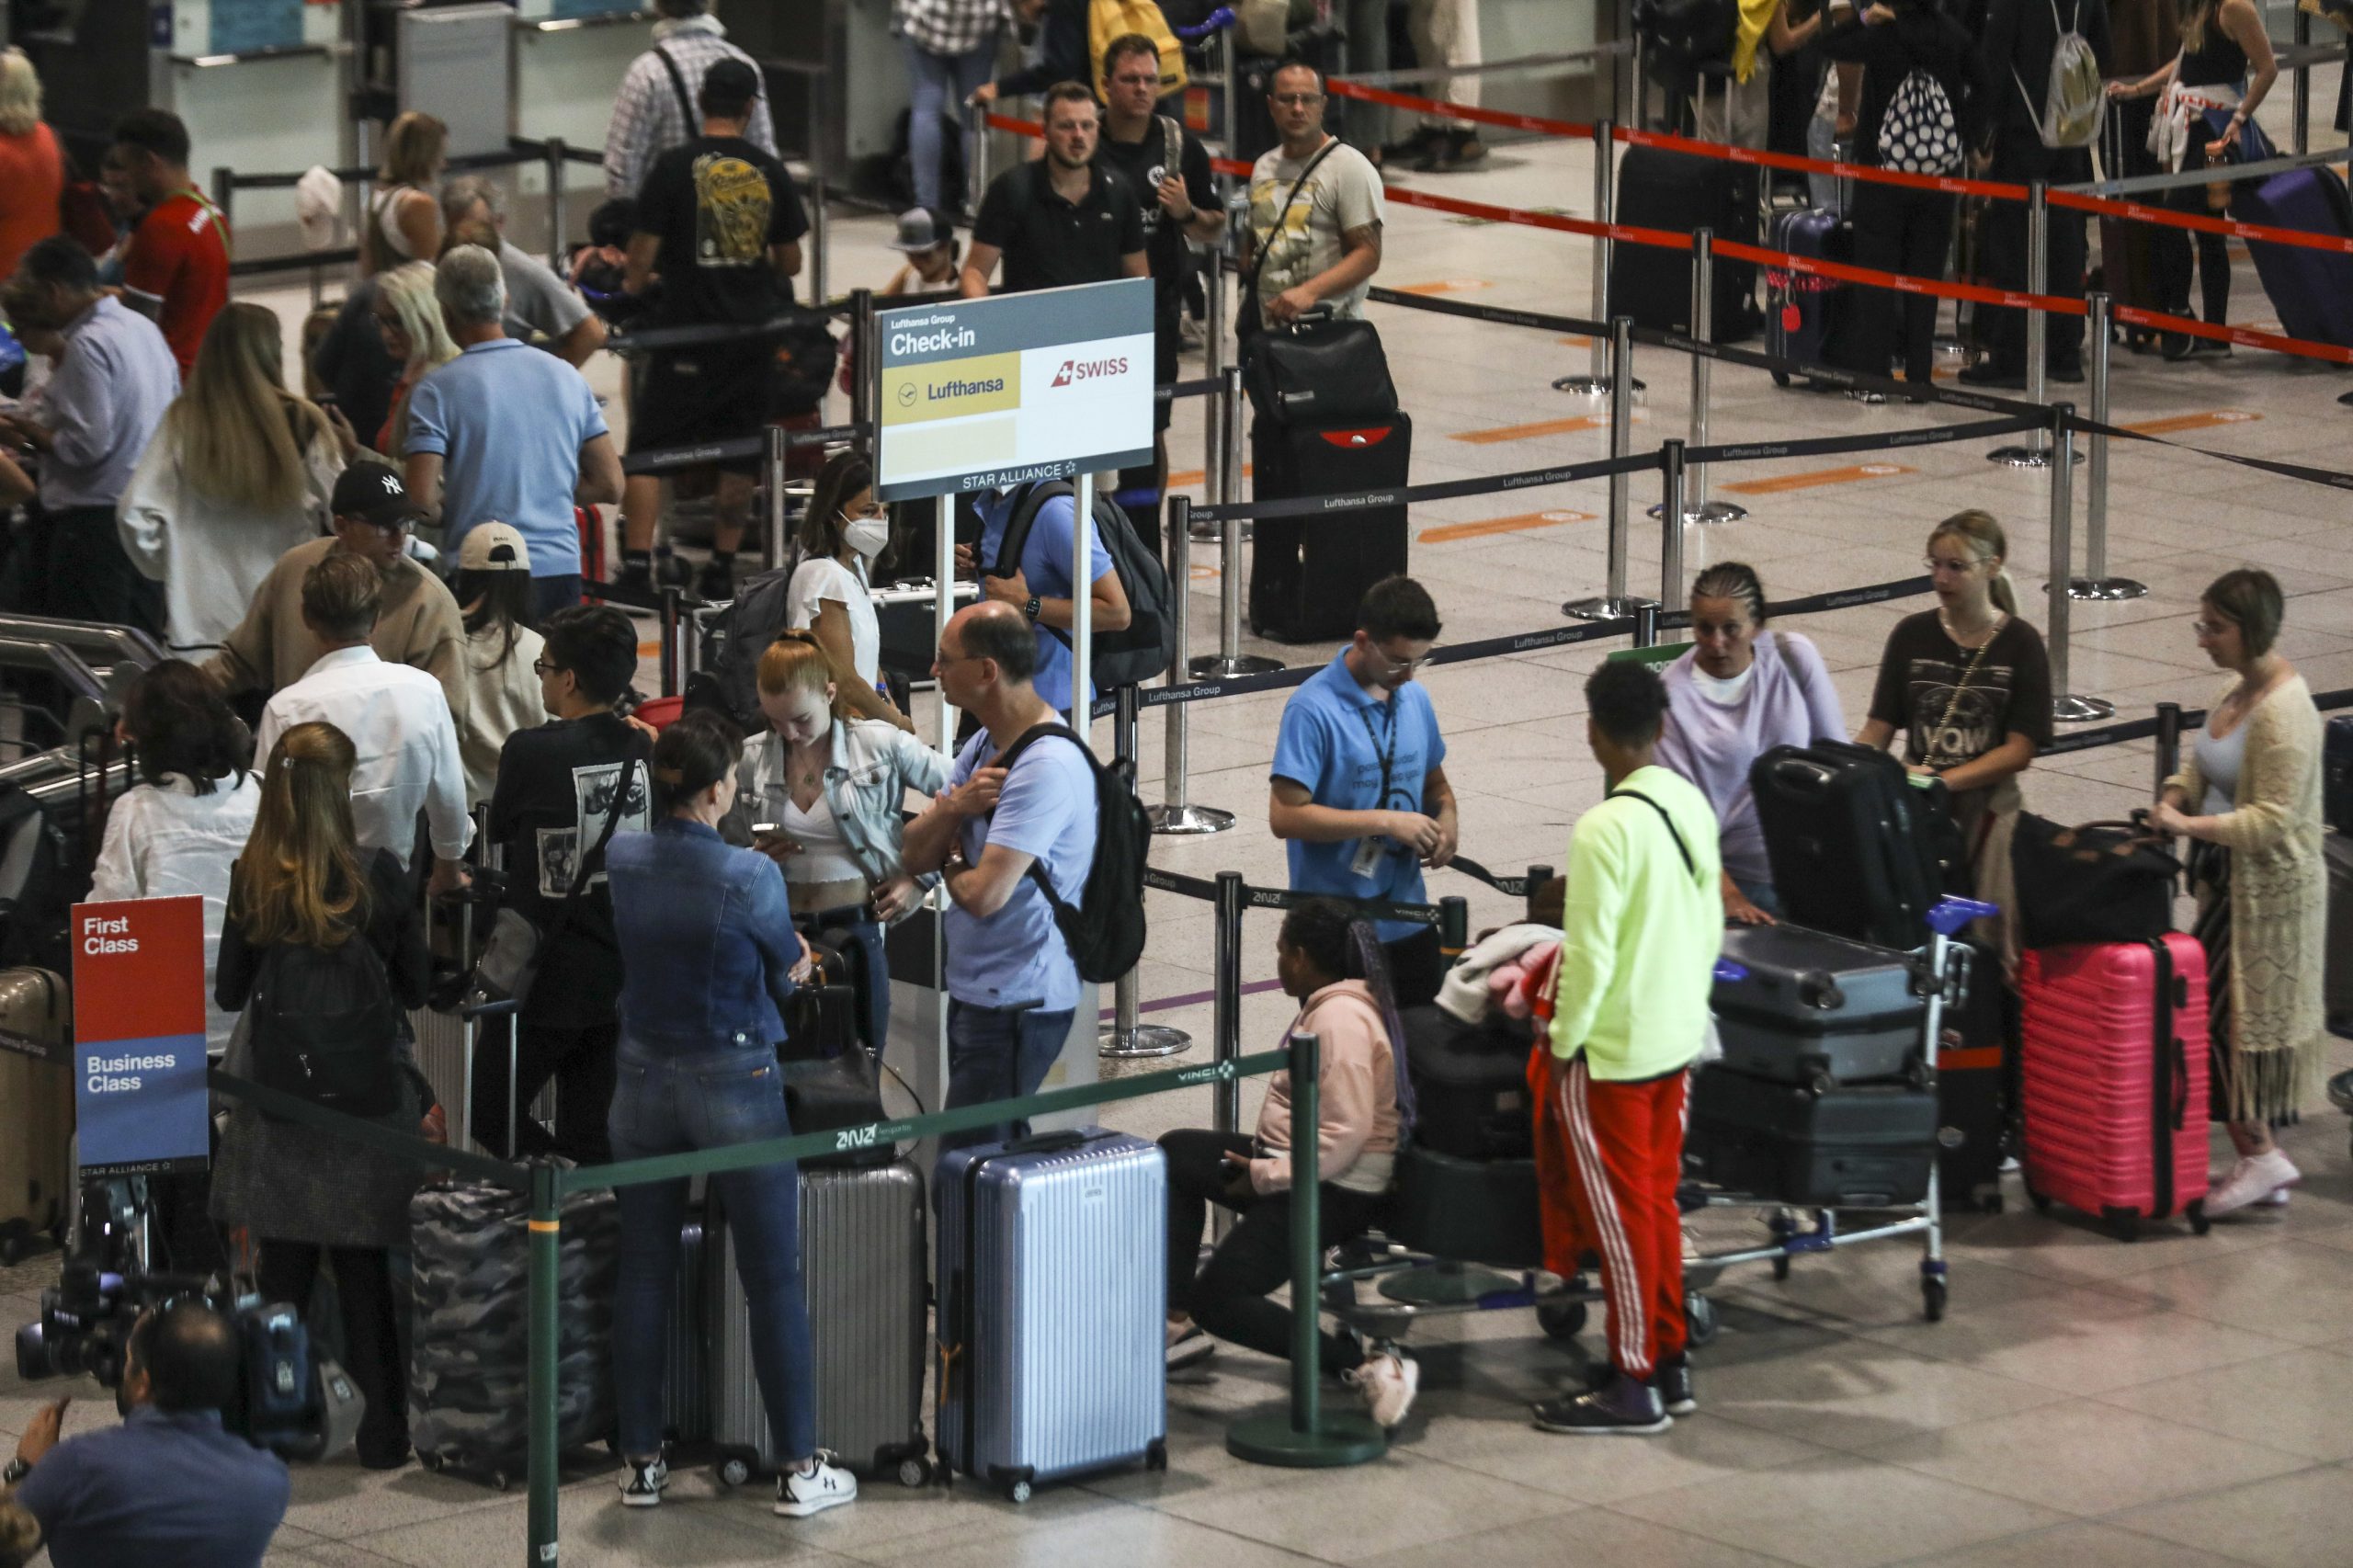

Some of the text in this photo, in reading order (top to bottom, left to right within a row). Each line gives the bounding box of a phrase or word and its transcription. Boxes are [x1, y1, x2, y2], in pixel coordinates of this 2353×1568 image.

[891, 313, 956, 330] Lufthansa Group
[891, 326, 975, 356] Check-in
[1075, 358, 1128, 380] SWISS
[928, 377, 1004, 401] Lufthansa
[1722, 444, 1788, 458] Lufthansa Group
[962, 464, 1062, 489] STAR ALLIANCE
[1503, 472, 1572, 488] Lufthansa Group
[1324, 494, 1394, 509] Lufthansa Group
[1515, 631, 1583, 649] Lufthansa Group
[1149, 687, 1221, 702] Lufthansa Group
[1150, 873, 1176, 889] Group
[1395, 908, 1425, 917] VINCI
[84, 916, 129, 935] First
[84, 937, 139, 955] Class
[87, 1053, 176, 1074] Business
[1178, 1067, 1215, 1081] VINCI
[87, 1074, 142, 1093] Class
[81, 1163, 159, 1176] STAR ALLIANCE
